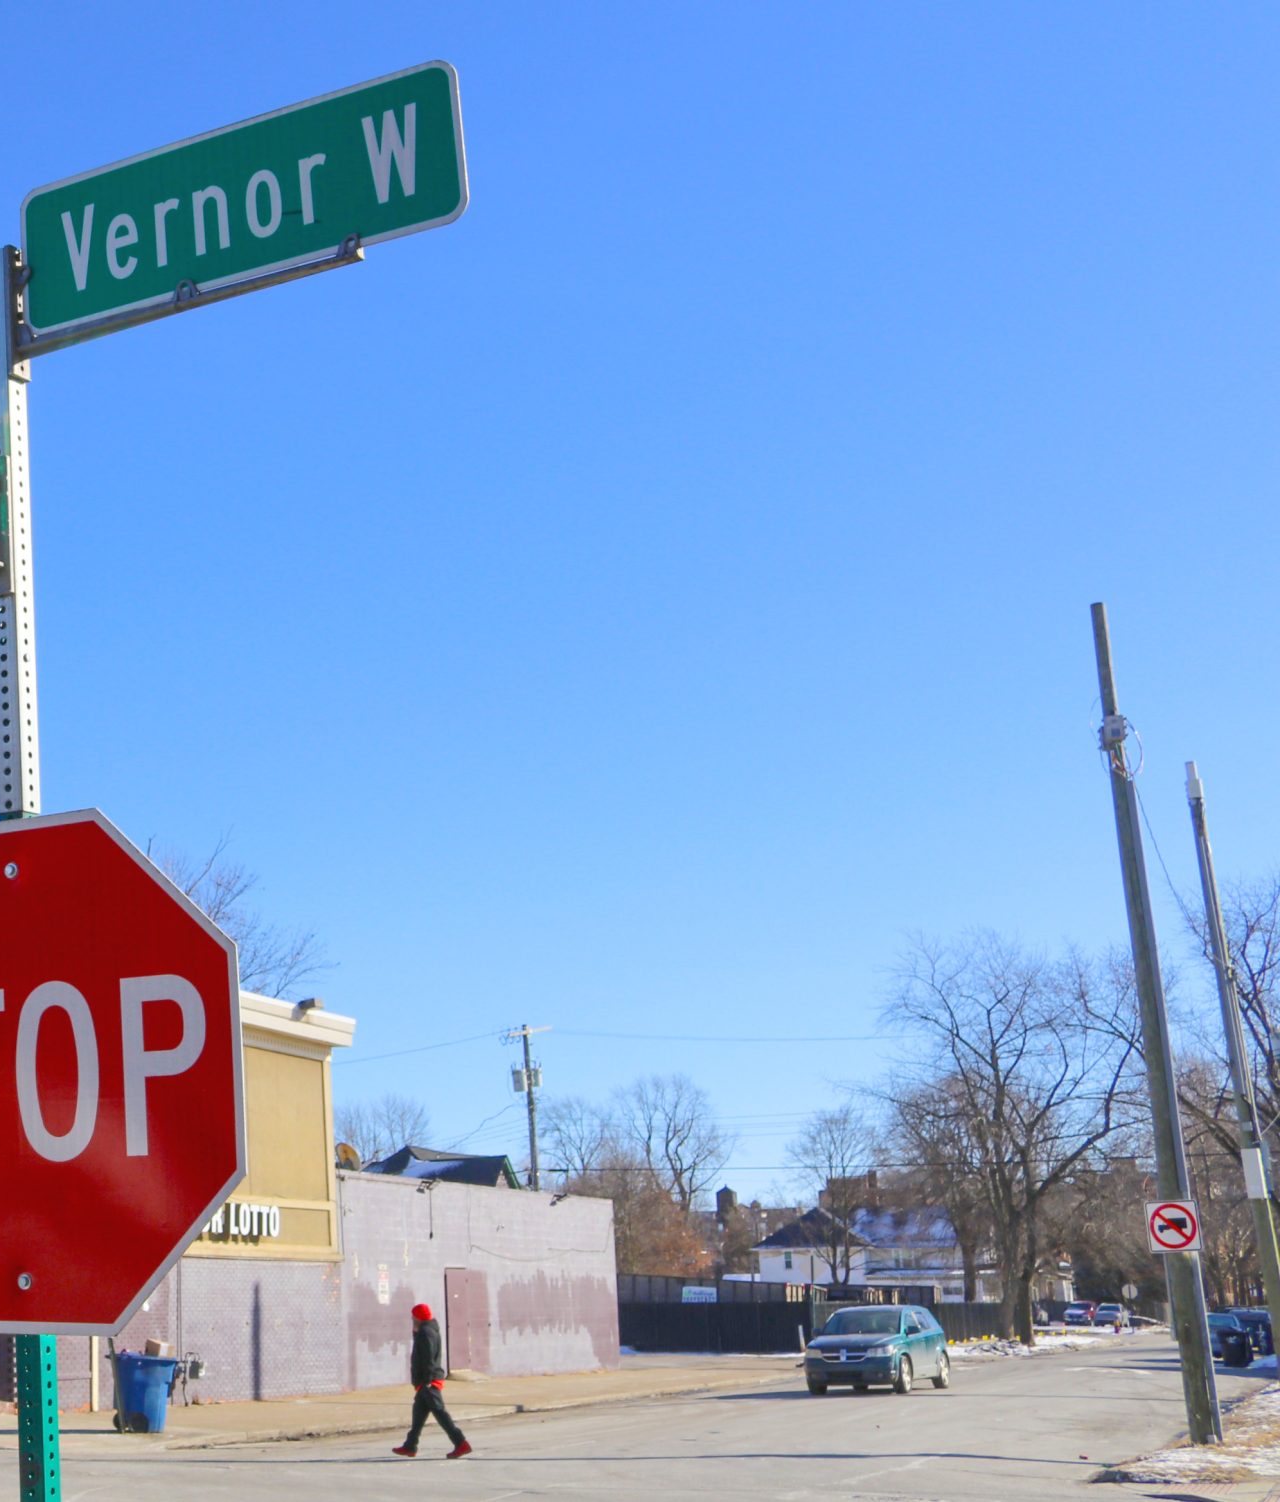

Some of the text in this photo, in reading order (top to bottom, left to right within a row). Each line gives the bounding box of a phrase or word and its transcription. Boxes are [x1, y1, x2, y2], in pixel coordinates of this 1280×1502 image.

[60, 102, 417, 291] Vernor W
[229, 1203, 280, 1238] LOTTO
